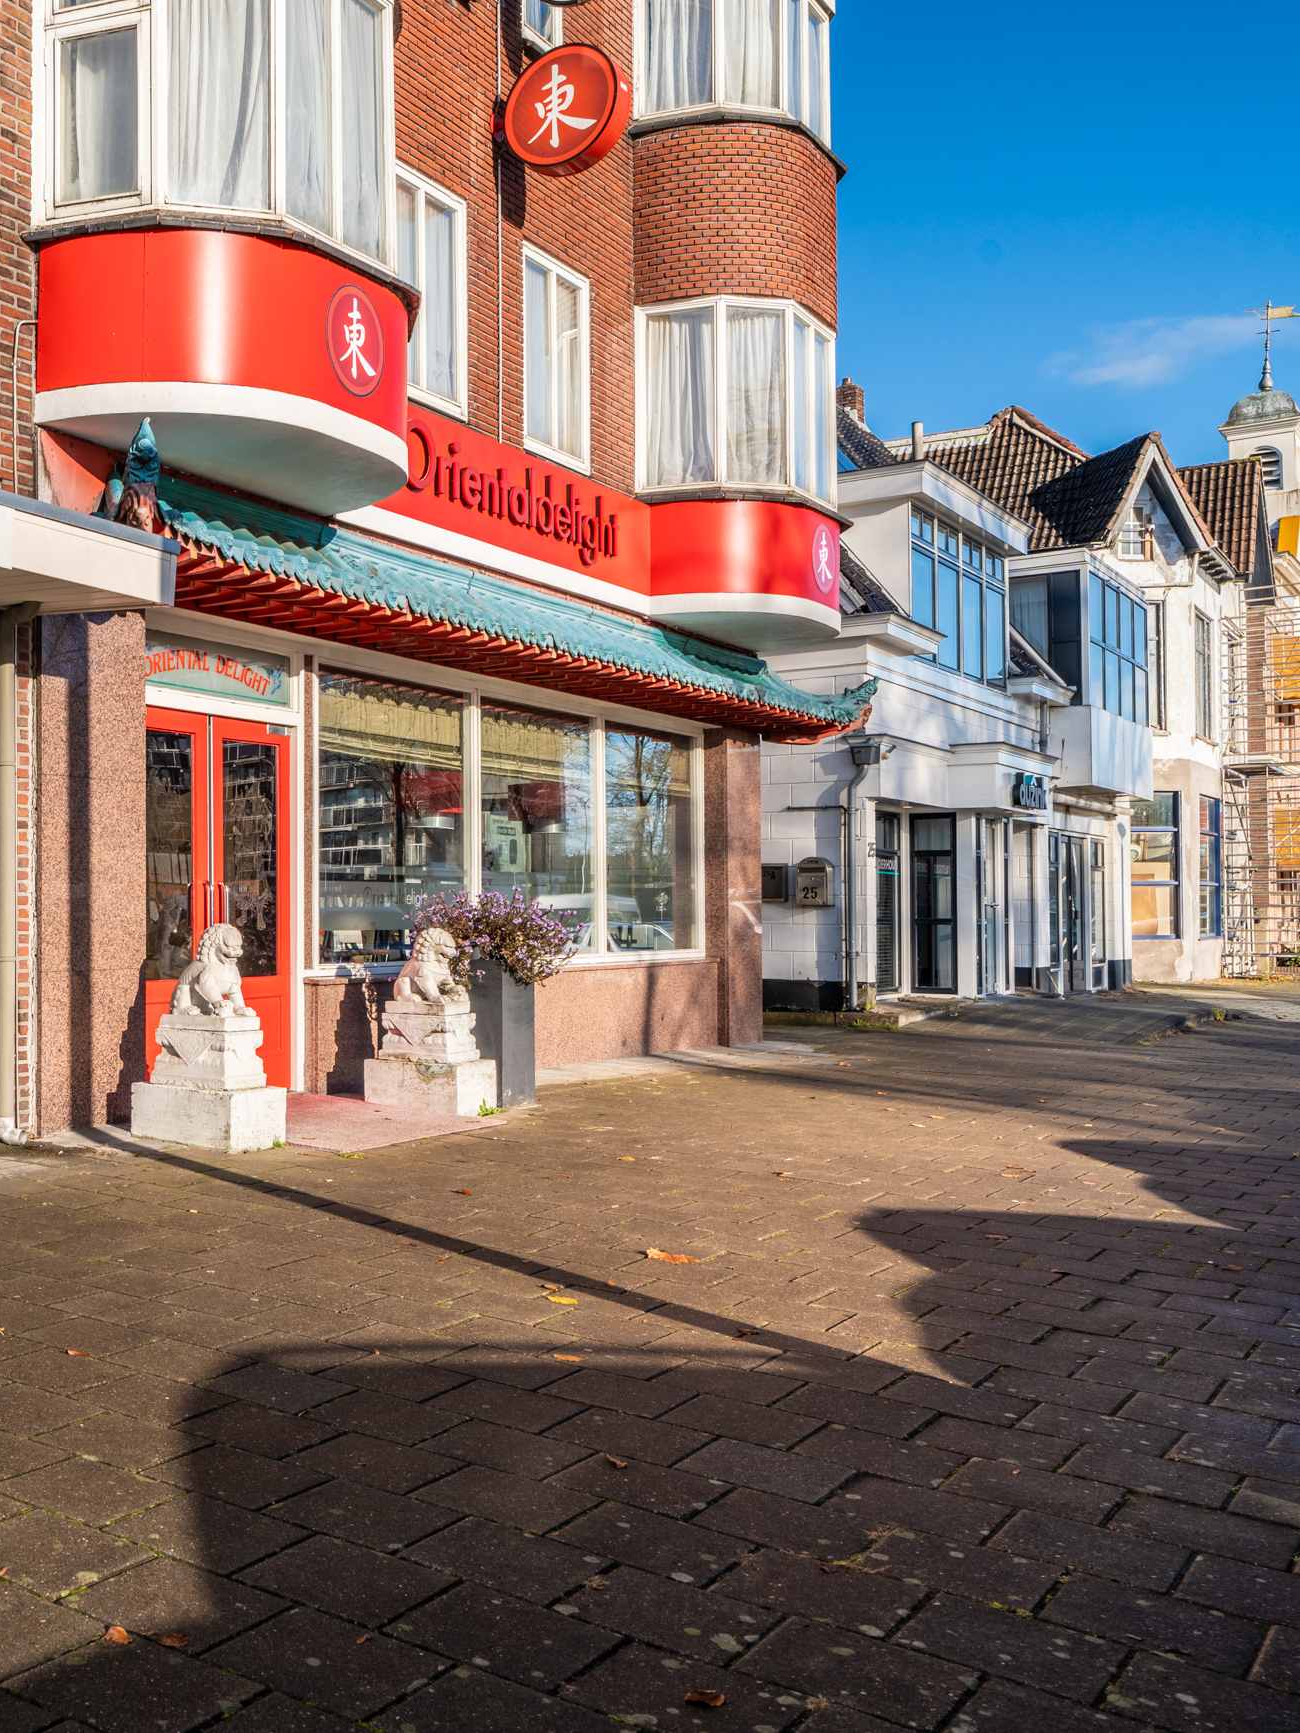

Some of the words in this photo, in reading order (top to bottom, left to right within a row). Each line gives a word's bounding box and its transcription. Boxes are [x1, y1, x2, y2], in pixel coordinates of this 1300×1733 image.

[528, 64, 597, 149] 東
[339, 297, 377, 380] 東
[407, 419, 620, 567] Orientaldelight
[816, 531, 833, 583] 東
[145, 650, 210, 678] ORIENTAL
[215, 654, 271, 696] DELIGHT
[363, 886, 428, 909] Orientaldeligh
[802, 886, 818, 899] 25
